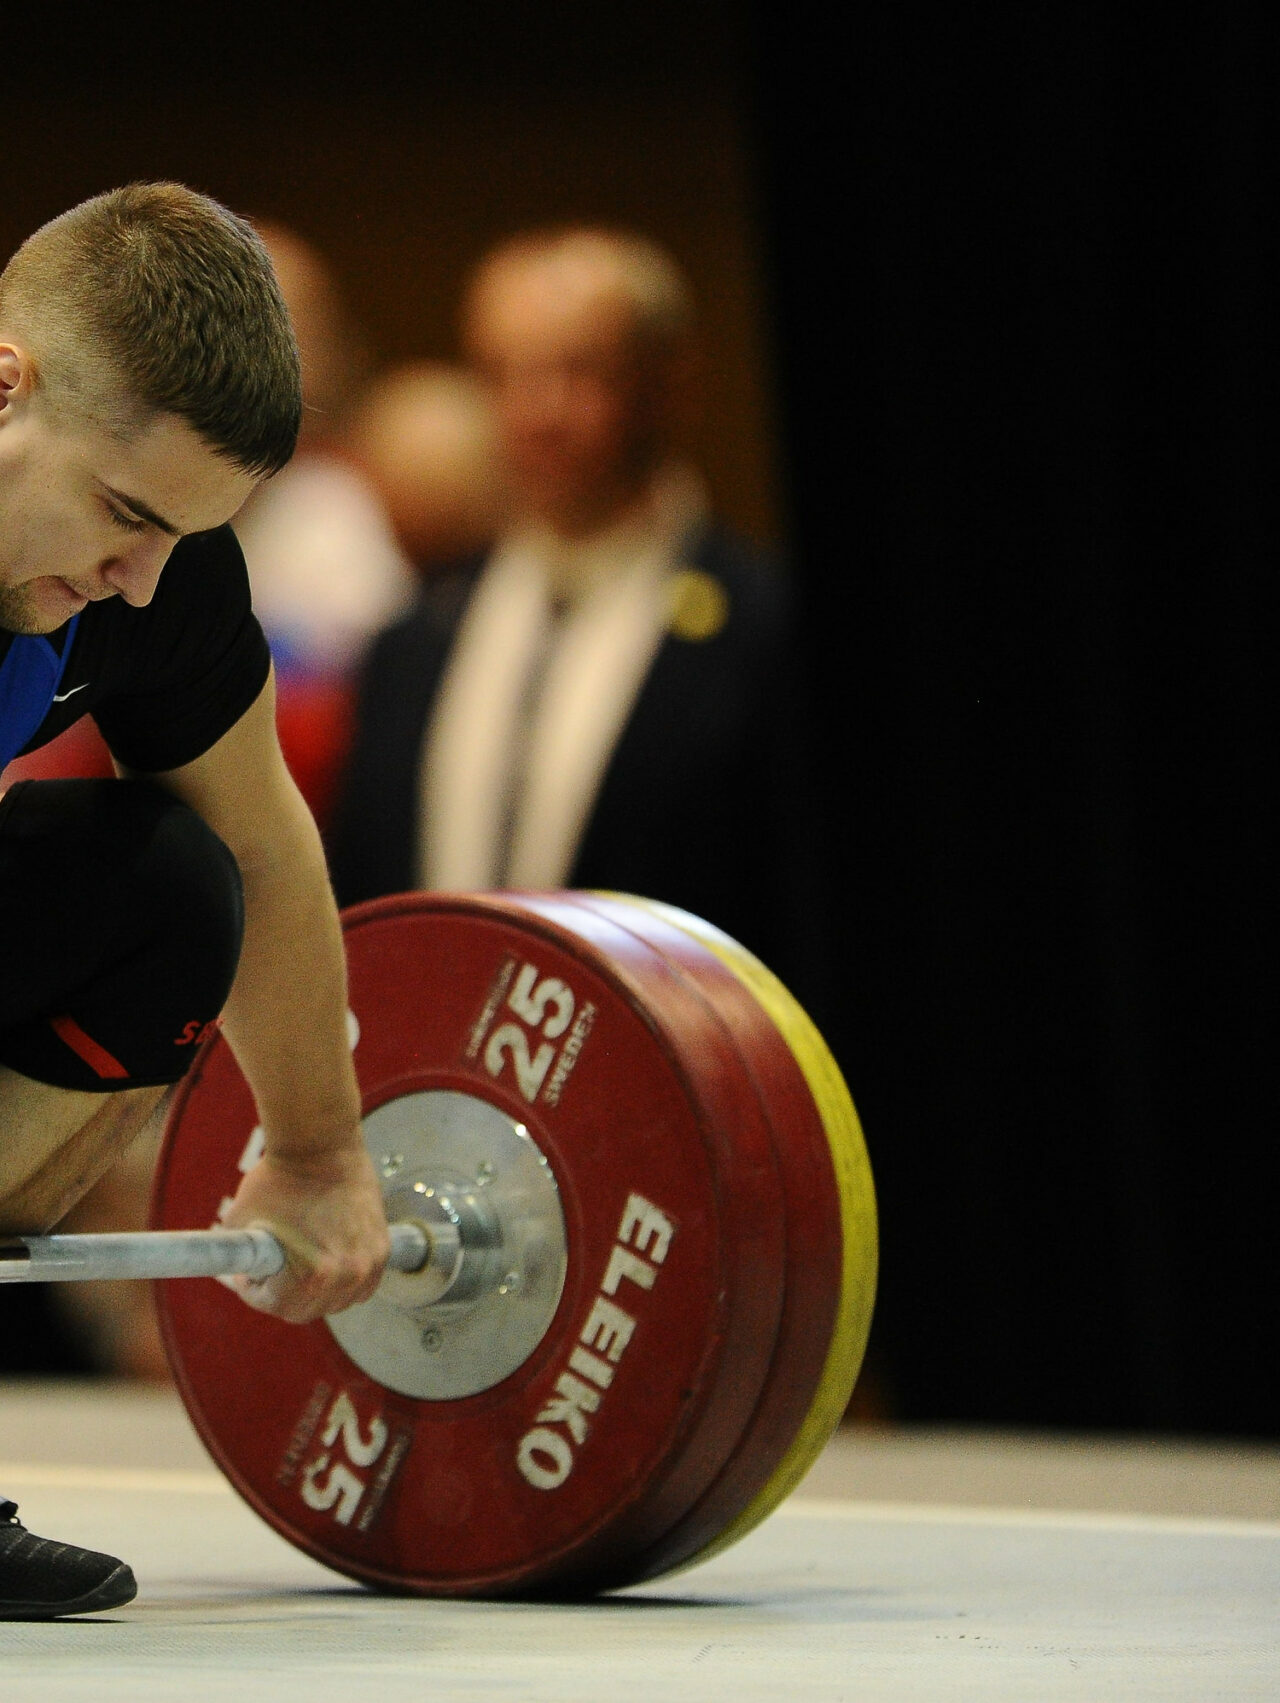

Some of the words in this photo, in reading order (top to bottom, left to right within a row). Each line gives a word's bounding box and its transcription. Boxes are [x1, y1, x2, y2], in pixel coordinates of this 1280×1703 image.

[484, 961, 575, 1104] 25
[542, 1000, 597, 1109] SWEDEN
[516, 1191, 675, 1491] ELEIKO
[301, 1390, 389, 1526] 25
